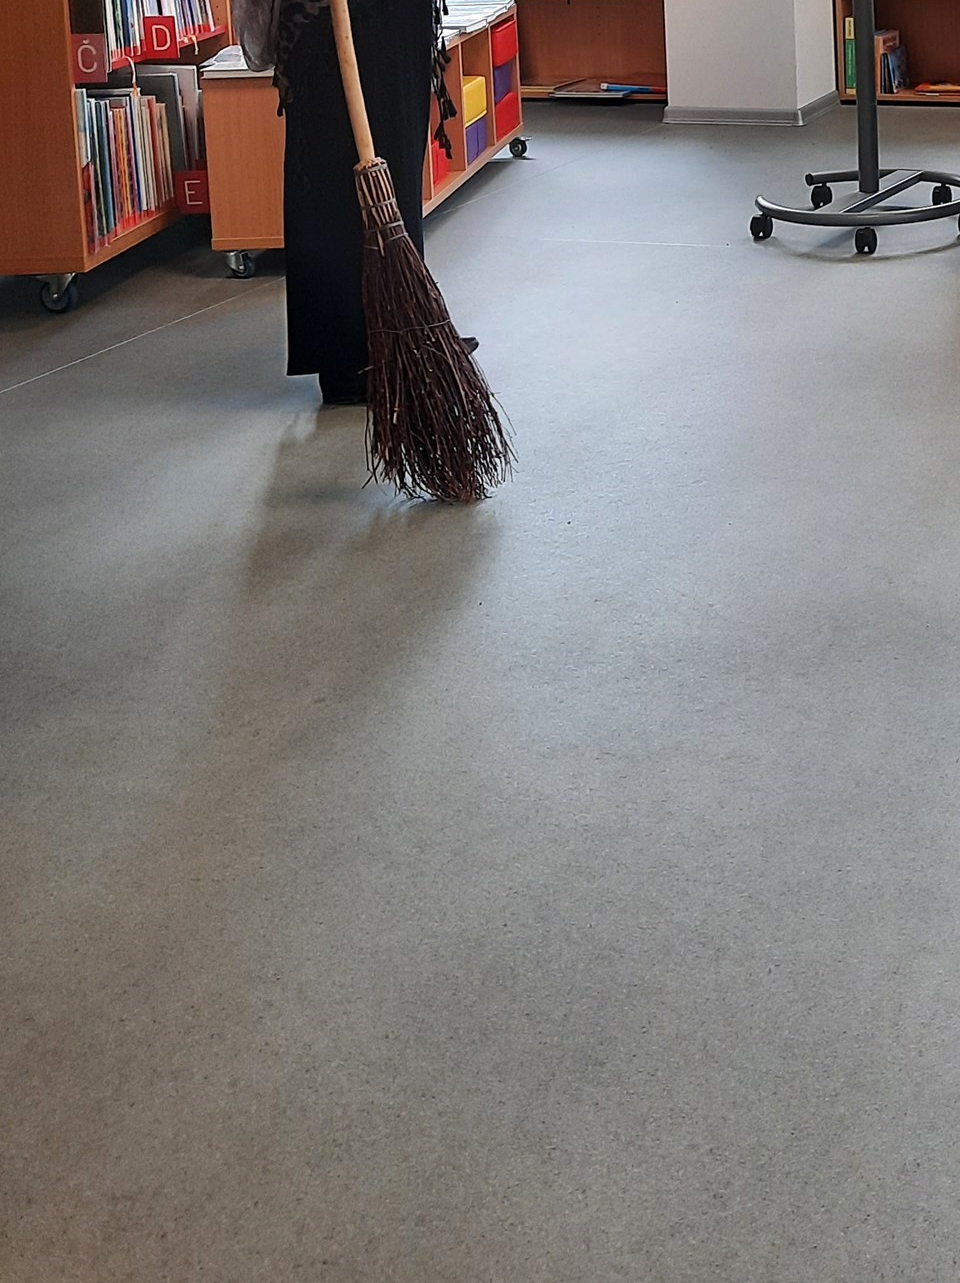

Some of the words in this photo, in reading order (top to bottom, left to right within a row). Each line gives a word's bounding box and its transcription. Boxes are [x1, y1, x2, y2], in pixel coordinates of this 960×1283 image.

[151, 25, 170, 51] D
[77, 39, 97, 73] Č
[184, 180, 203, 204] E
